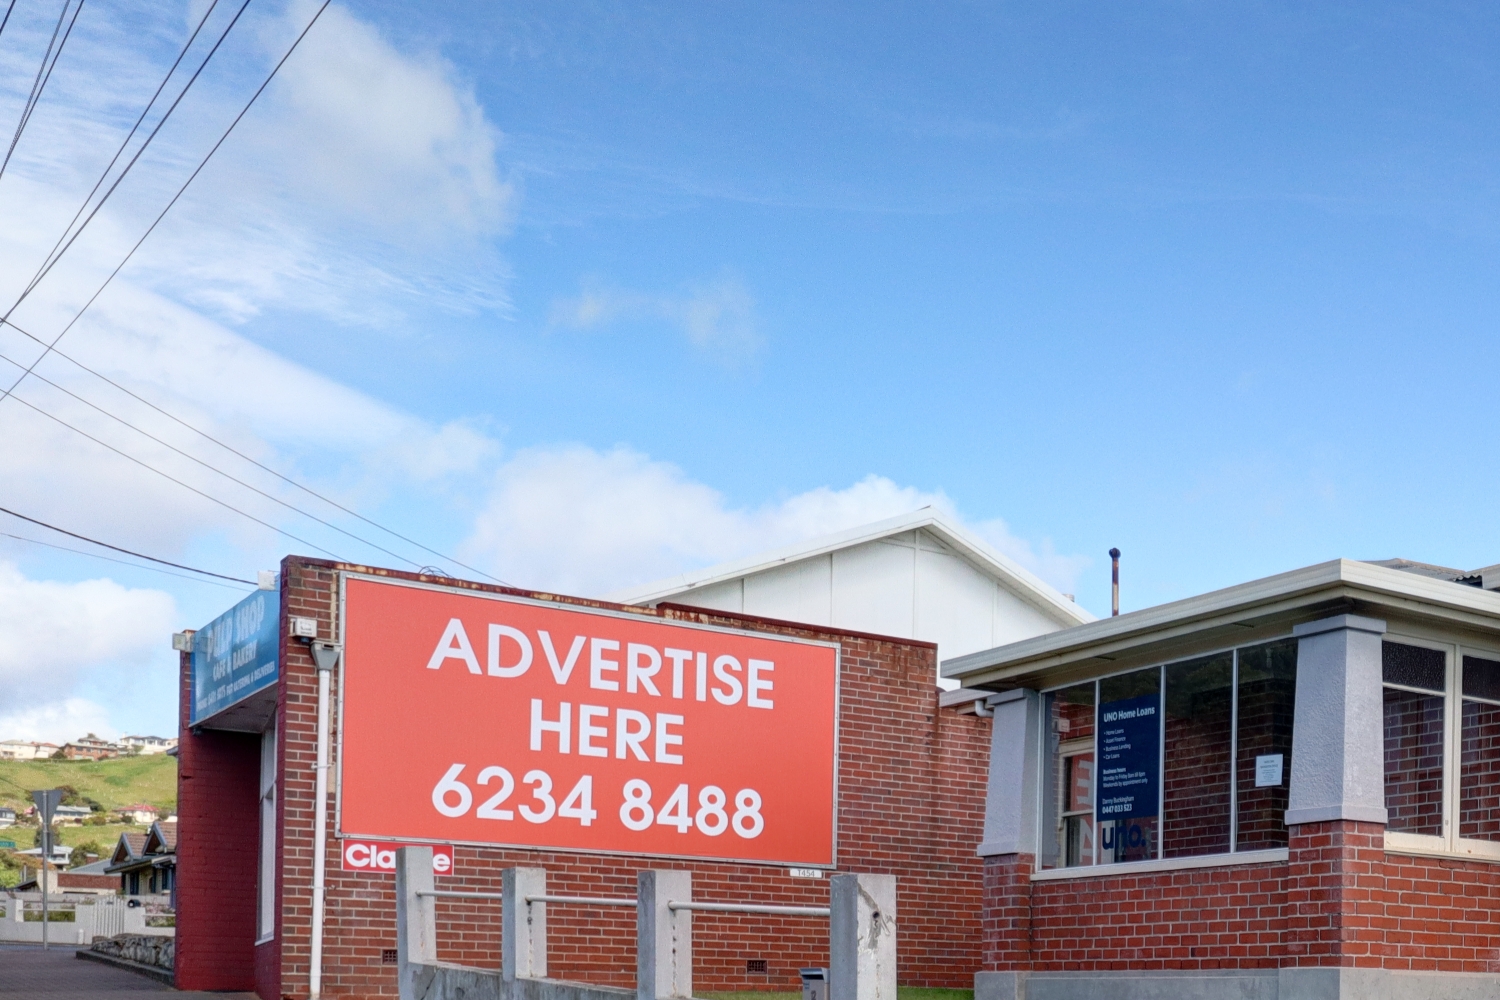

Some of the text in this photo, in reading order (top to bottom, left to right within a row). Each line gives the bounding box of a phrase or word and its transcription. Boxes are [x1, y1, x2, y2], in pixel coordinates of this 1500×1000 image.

[236, 595, 265, 644] SHOP
[233, 639, 257, 670] BAKERY
[426, 617, 775, 709] ADVERTISE
[530, 698, 684, 765] HERE
[1103, 707, 1155, 722] UNO Home Loans
[432, 763, 764, 839] 6234 8488
[1102, 805, 1114, 814] 0447
[345, 843, 451, 872] Clae
